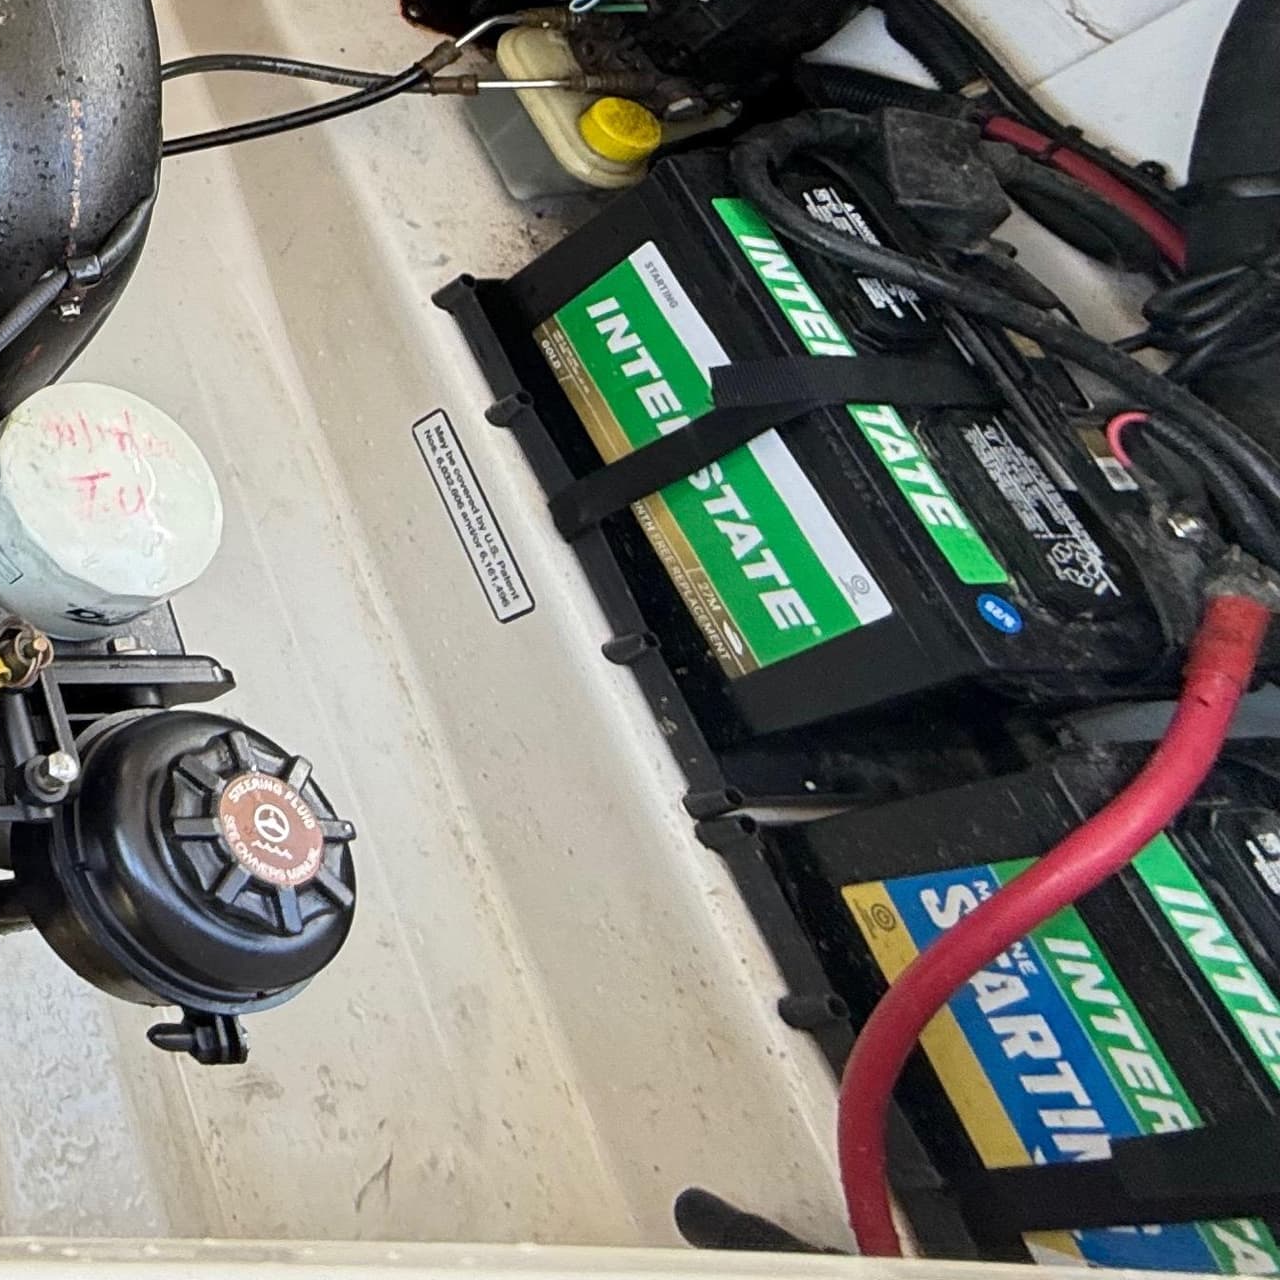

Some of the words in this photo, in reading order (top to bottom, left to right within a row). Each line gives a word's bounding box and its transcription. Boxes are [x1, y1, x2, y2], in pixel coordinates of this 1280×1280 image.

[644, 261, 679, 309] STARTING
[541, 339, 562, 369] GOLD
[423, 428, 438, 456] Nos.
[460, 511, 483, 549] and/or
[434, 424, 448, 449] May
[445, 450, 457, 467] be
[453, 467, 481, 512] covered
[476, 514, 487, 531] by
[484, 533, 499, 559] U.S.
[496, 560, 520, 600] Patent
[228, 778, 283, 803] STEERING
[284, 790, 316, 829] FLUID
[1154, 884, 1280, 1062] INTE
